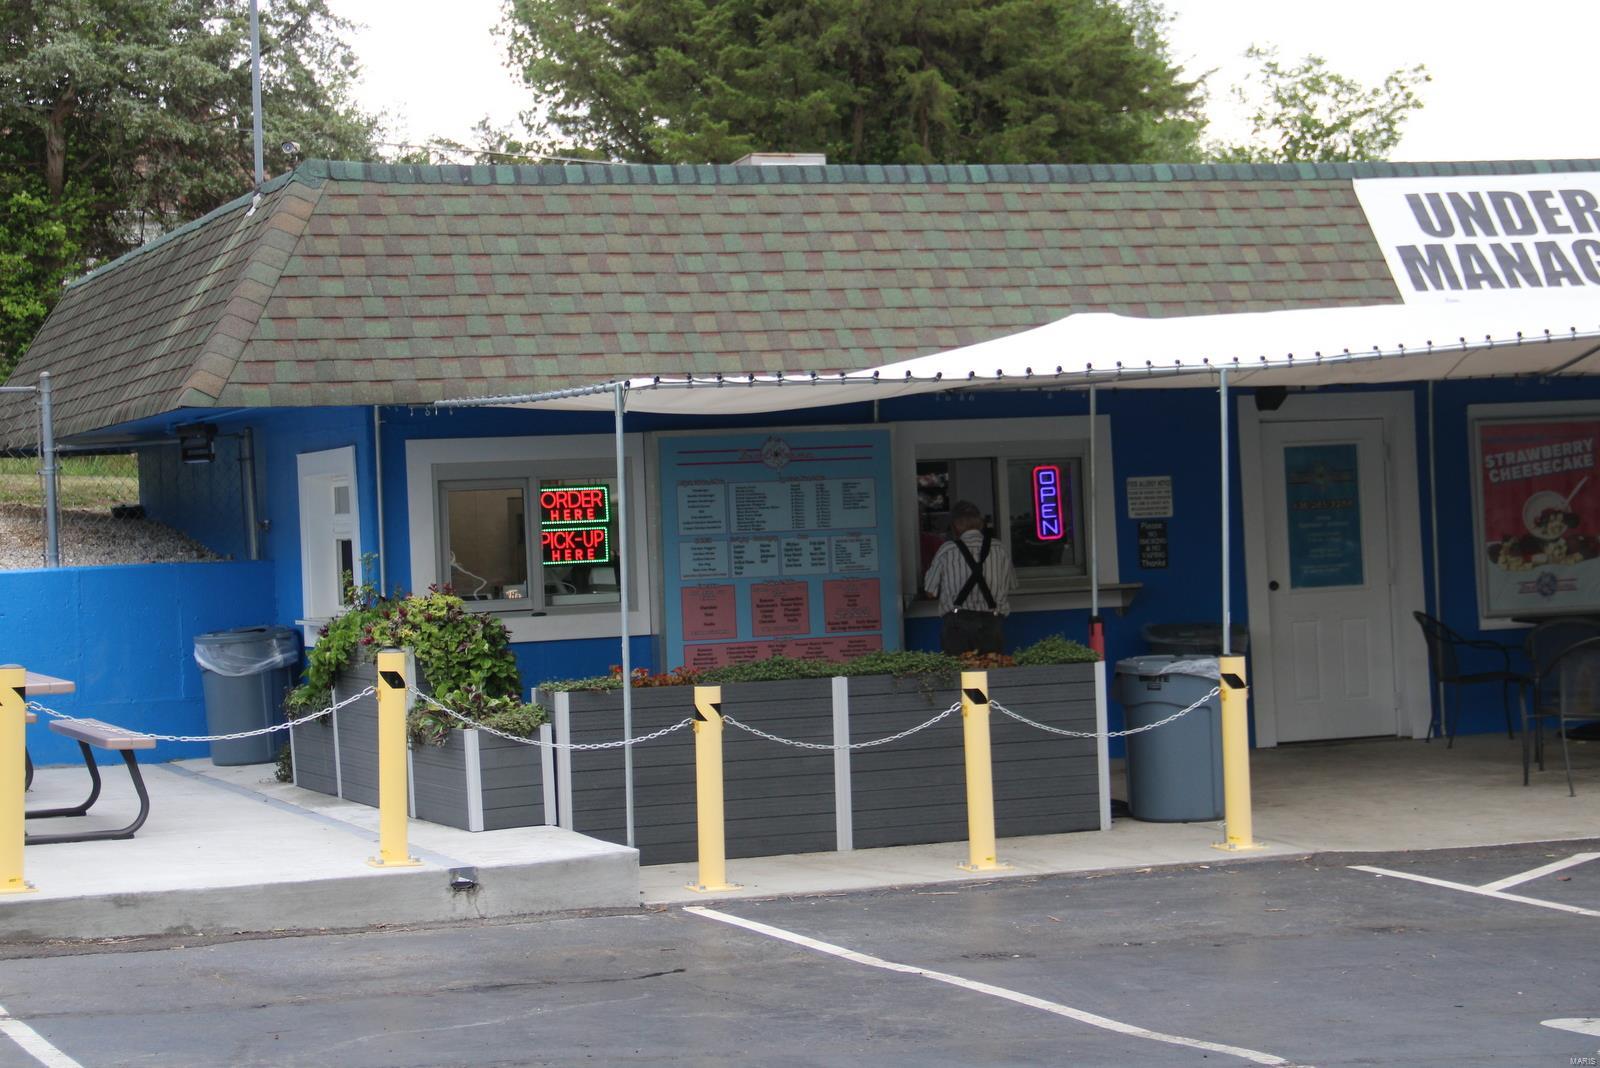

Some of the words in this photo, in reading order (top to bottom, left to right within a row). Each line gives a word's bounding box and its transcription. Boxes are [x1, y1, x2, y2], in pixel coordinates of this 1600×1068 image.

[1404, 189, 1600, 238] UNDER
[1485, 438, 1593, 468] STRAWBERRY
[1488, 453, 1594, 482] CHEESECAKE
[540, 490, 603, 509] ORDER
[1039, 471, 1059, 535] OPEN
[550, 508, 596, 521] HERE
[541, 530, 604, 549] PICK-UP
[551, 548, 596, 561] HERE
